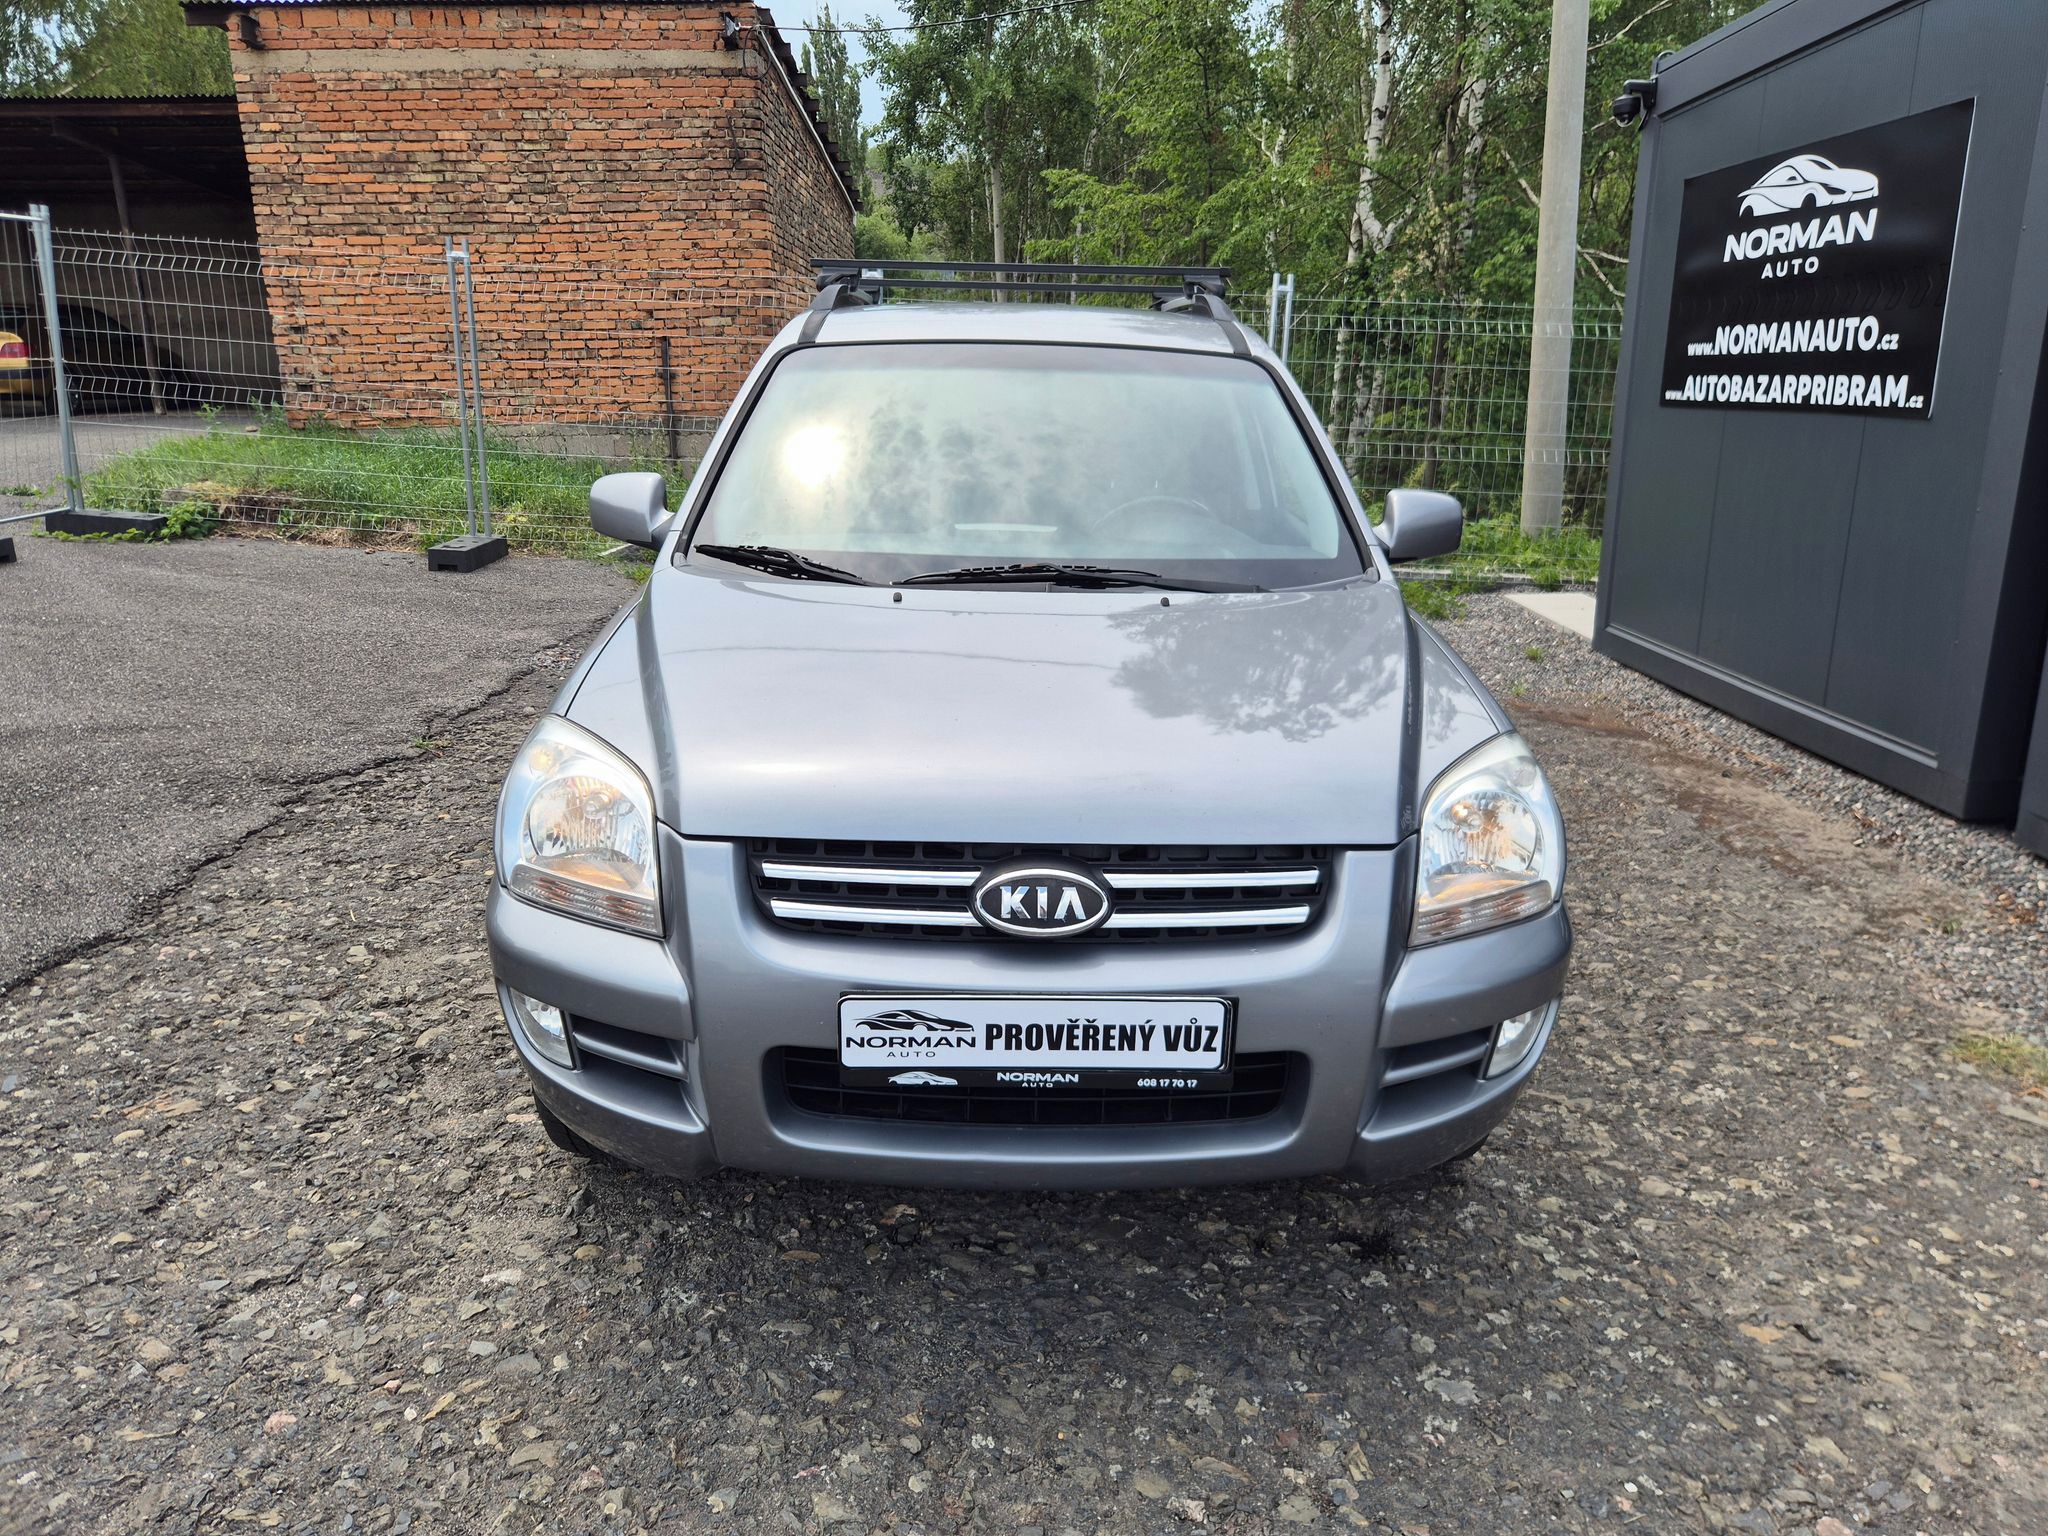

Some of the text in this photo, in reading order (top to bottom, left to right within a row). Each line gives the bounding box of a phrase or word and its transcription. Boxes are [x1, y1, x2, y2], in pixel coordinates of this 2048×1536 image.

[1723, 208, 1879, 263] NORMAN
[1760, 255, 1820, 280] AUTO
[1687, 315, 1900, 357] www.NORMANAUTO.cz
[1665, 374, 1924, 409] www.AUTOBAZARPRIBRAM.cz
[1000, 885, 1087, 921] KIA
[845, 1036, 976, 1049] NORMAN
[985, 1017, 1219, 1053] PROVĚŘENÝ VŮZ
[886, 1050, 936, 1058] AUTO
[996, 1072, 1079, 1083] NORMAN
[1137, 1078, 1198, 1088] 608 17 70 17
